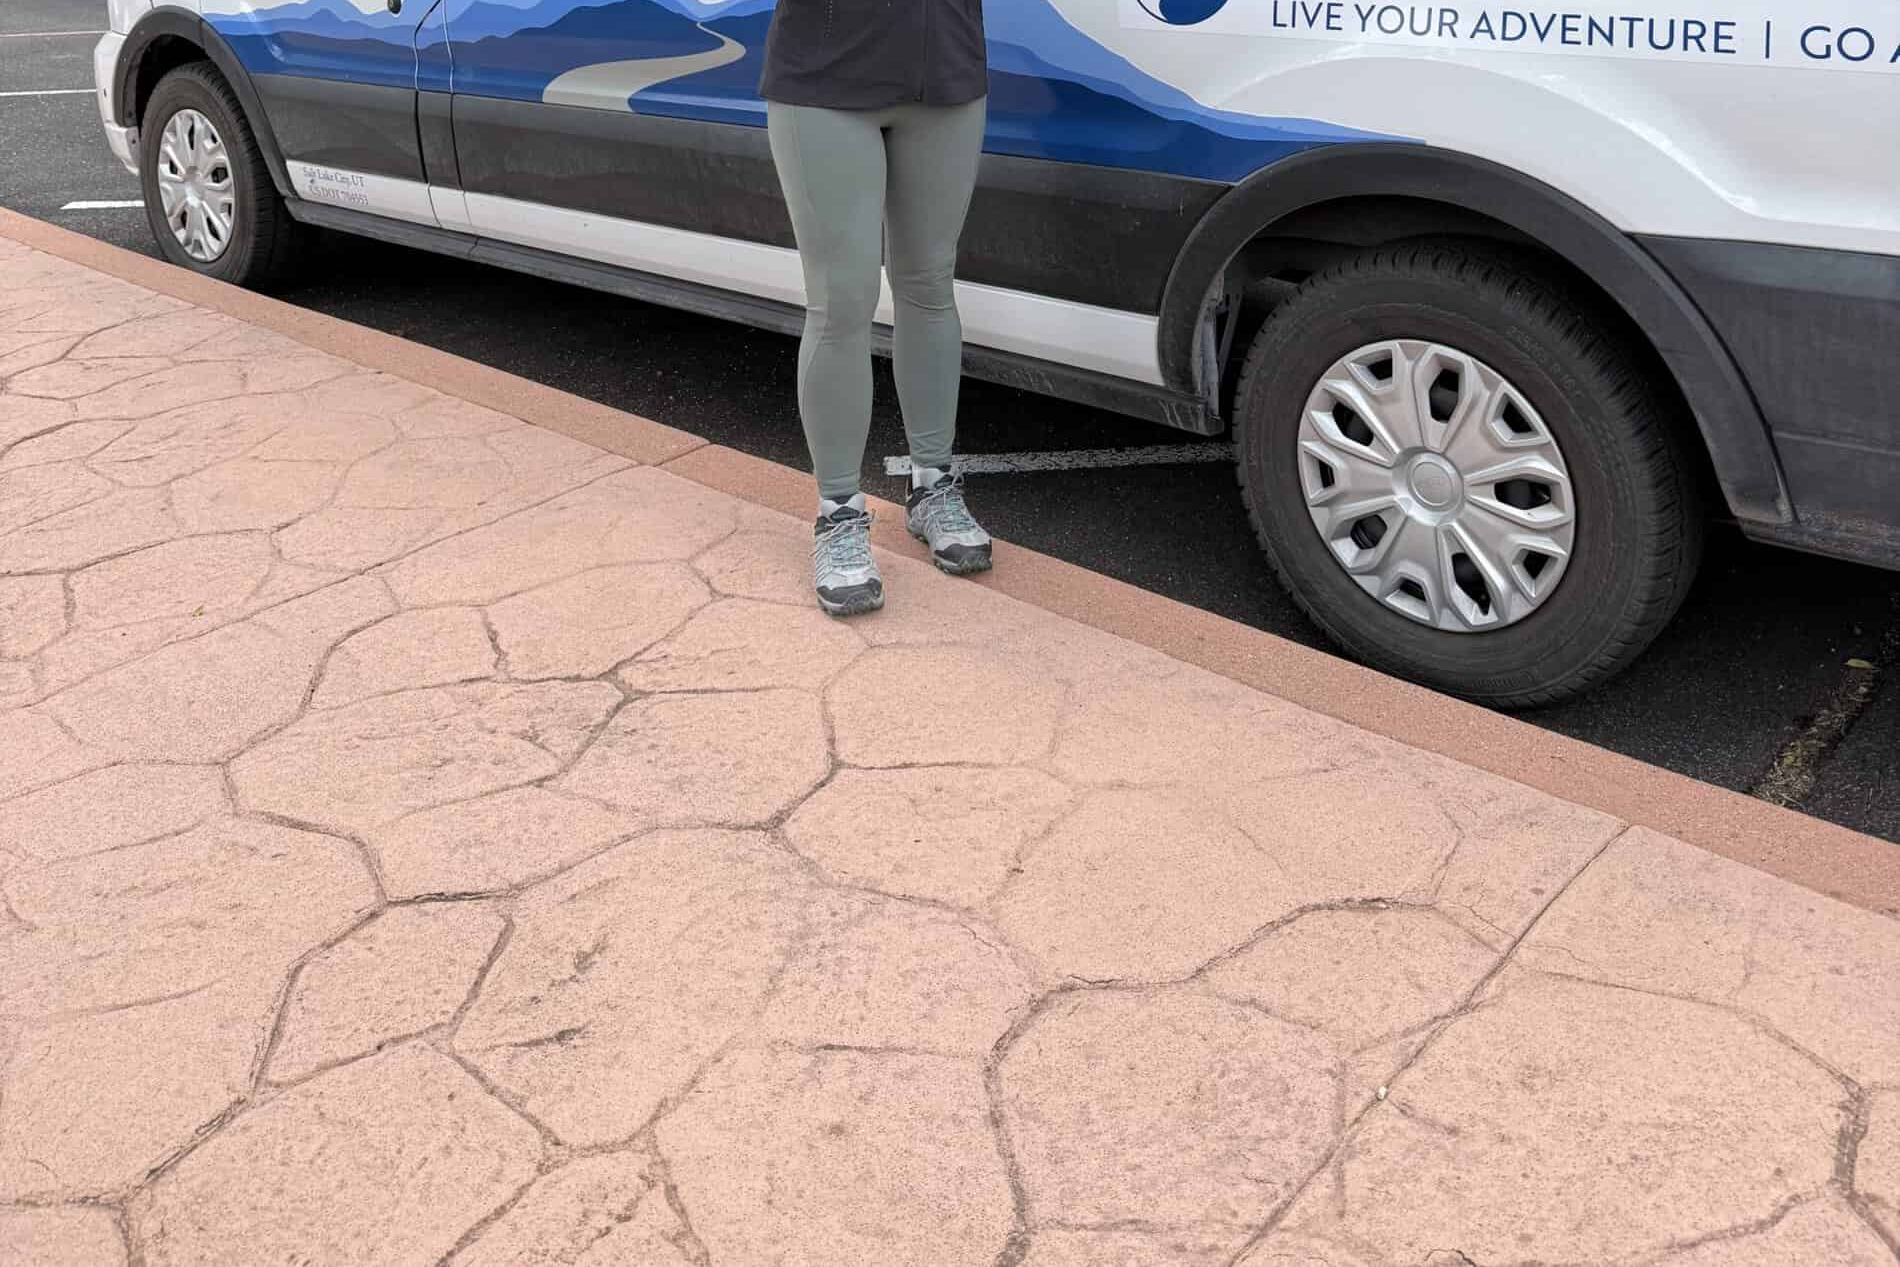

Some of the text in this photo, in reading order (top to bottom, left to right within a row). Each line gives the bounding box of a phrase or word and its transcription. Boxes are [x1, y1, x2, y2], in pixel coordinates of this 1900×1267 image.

[1272, 0, 1343, 32] LIVE
[1354, 3, 1460, 40] YOUR
[1470, 10, 1737, 55] ADVENTURE
[1799, 25, 1875, 63] GO
